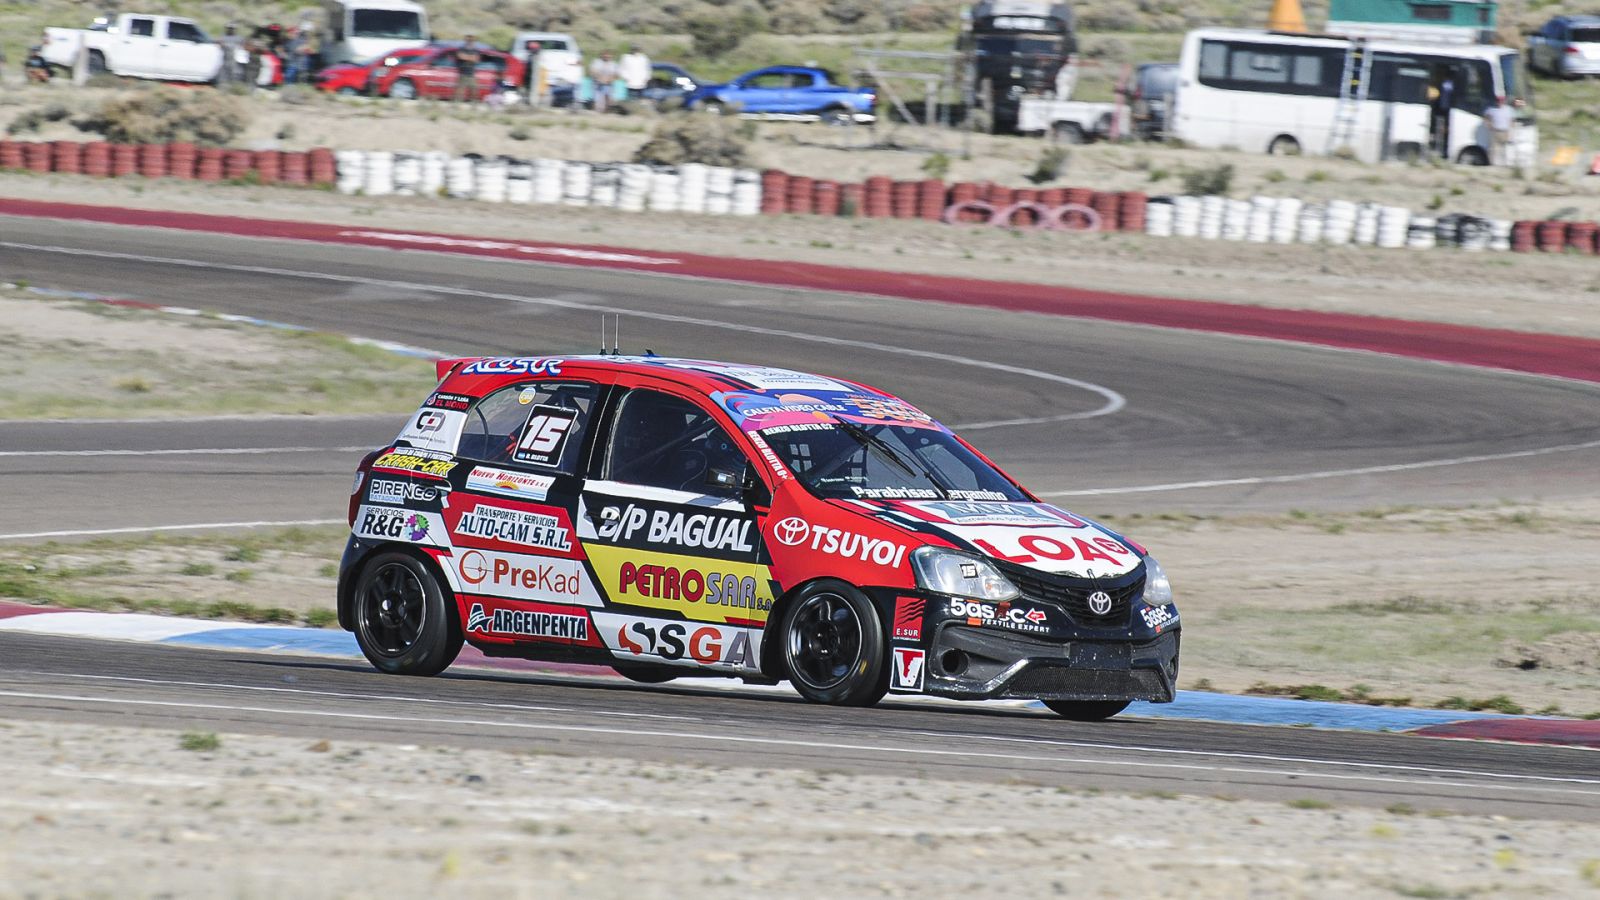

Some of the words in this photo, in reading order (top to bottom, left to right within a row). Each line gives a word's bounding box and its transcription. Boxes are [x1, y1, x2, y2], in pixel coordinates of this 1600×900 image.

[743, 407, 781, 417] CALETA
[781, 404, 813, 412] VIDEO
[520, 415, 571, 452] 15
[374, 454, 456, 477] CRASH-CAR
[471, 469, 494, 478] NUEVO
[496, 472, 536, 485] HORIZONTE
[370, 479, 438, 501] PIRENCO
[850, 486, 938, 498] Parabrisas
[946, 488, 1008, 502] ergamino
[366, 507, 405, 517] SERVICIOS
[476, 506, 516, 521] TRANSPORTE
[524, 514, 557, 527] SERVICIOS
[361, 514, 404, 537] R&G
[458, 515, 530, 542] AUTO-CAM
[532, 527, 569, 549] S.R.L.
[647, 510, 752, 552] BAGUAL
[811, 525, 906, 568] TSUYOI
[493, 558, 580, 595] PreKad
[961, 564, 977, 578] 15
[619, 561, 756, 609] PETROSAR
[492, 609, 588, 640] ARGENPENTA
[982, 619, 1015, 629] TEXTILE
[1018, 624, 1050, 633] EXPERT
[1140, 605, 1172, 628] 5asec
